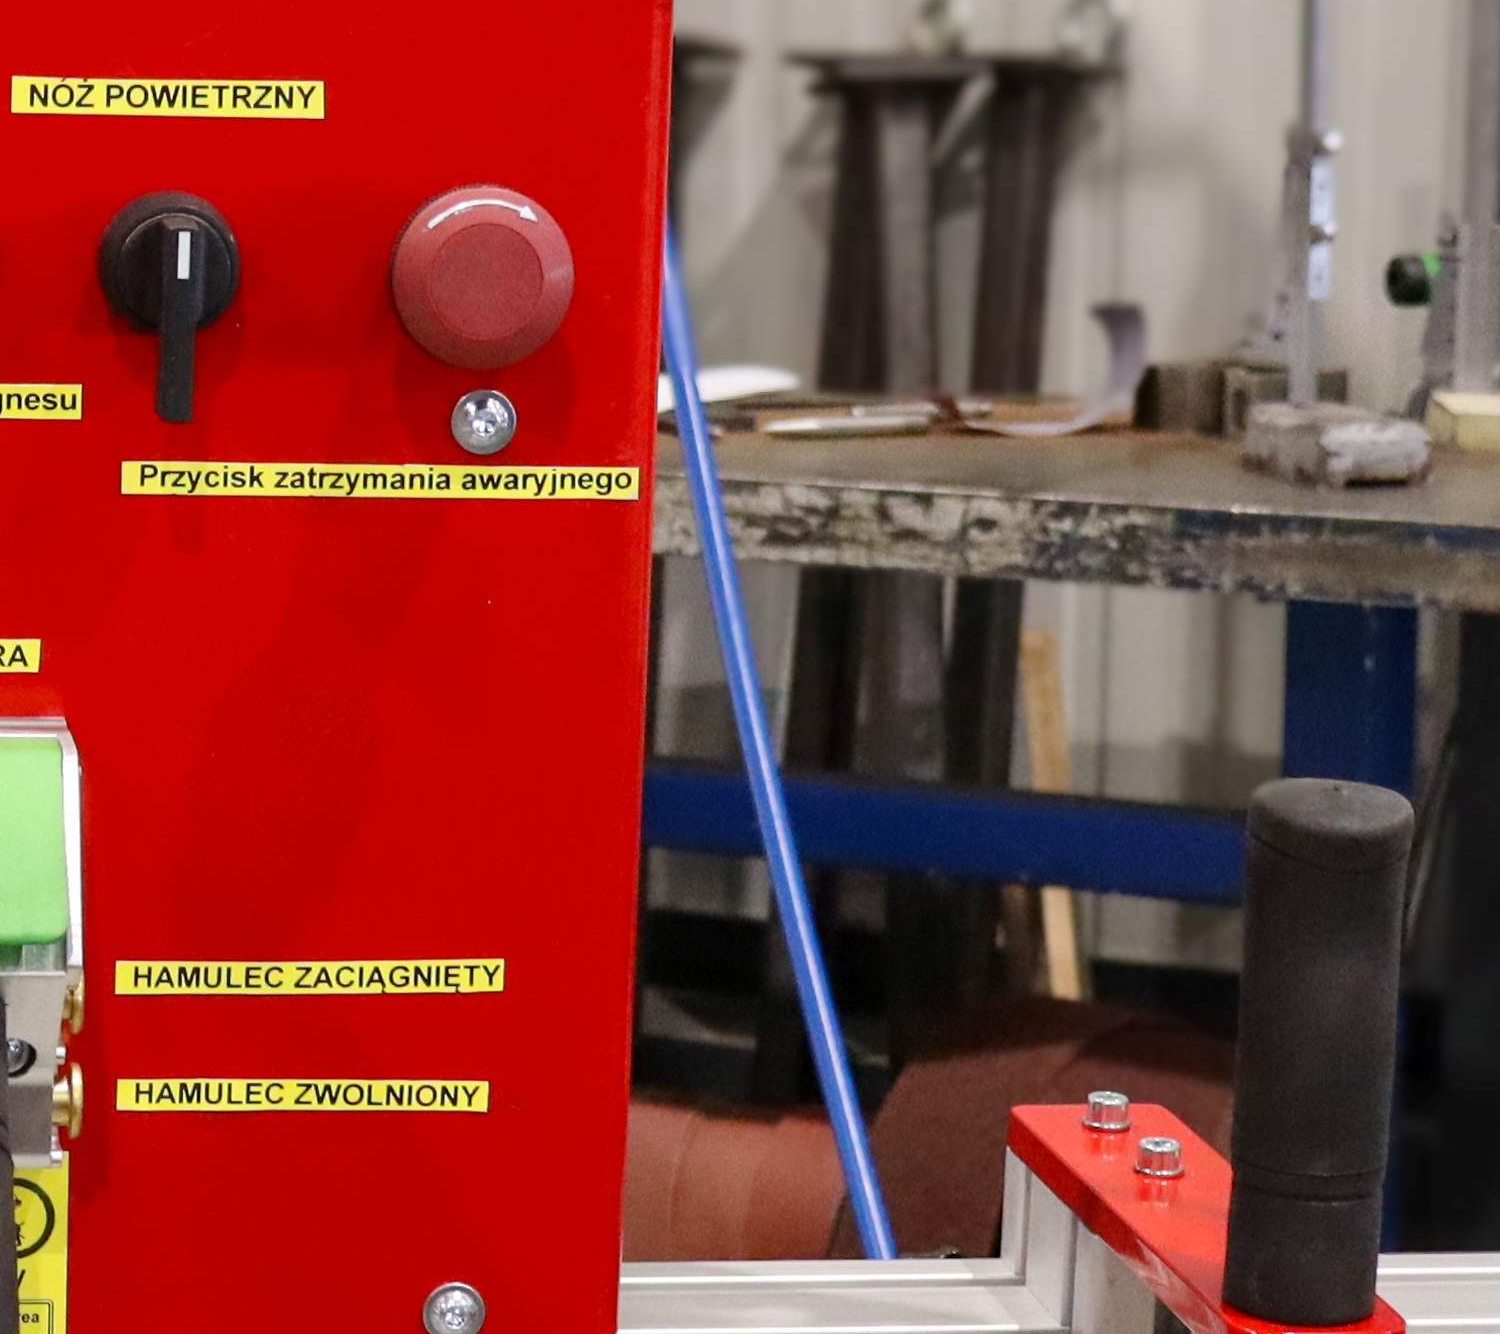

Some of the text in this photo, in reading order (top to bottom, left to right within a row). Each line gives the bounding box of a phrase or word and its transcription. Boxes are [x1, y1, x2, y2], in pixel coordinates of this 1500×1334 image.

[27, 77, 316, 110] NÓŻ POWIETRZNY
[138, 463, 633, 498] Przycisk zatrzymania awaryjnego
[132, 964, 503, 995] HAMULEC ZACIĄGNIĘTY
[134, 1082, 480, 1108] HAMULEC ZWOLNIONY
